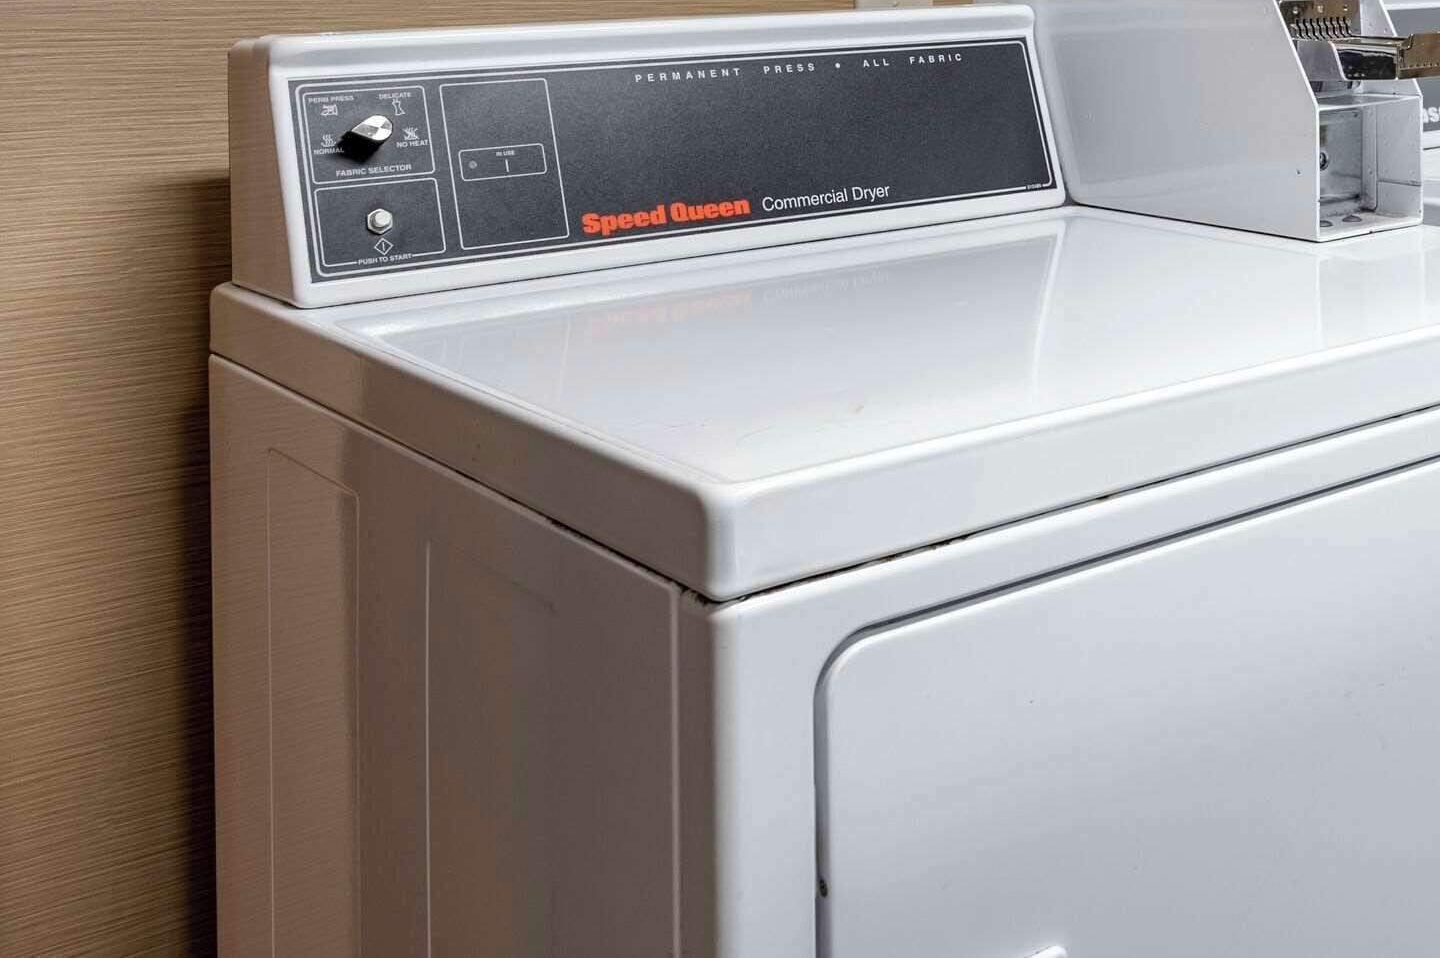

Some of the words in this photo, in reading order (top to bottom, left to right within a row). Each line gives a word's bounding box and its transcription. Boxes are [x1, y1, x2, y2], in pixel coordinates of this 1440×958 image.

[635, 67, 741, 83] PERMANENT
[763, 62, 816, 76] PRESS
[862, 58, 890, 68] ALL
[909, 53, 963, 65] FABRIC
[330, 95, 355, 103] PRESS
[378, 92, 413, 100] DELICATE
[409, 139, 430, 147] HEAT
[313, 147, 345, 155] NORMAL
[335, 167, 367, 177] FABRIC
[368, 163, 412, 174] SELECTOR
[582, 205, 668, 236] Speed
[670, 198, 752, 222] Queen
[762, 188, 848, 212] Commercial
[852, 184, 891, 203] Dryer
[358, 257, 378, 266] PUSH
[379, 255, 389, 263] TO
[389, 252, 412, 262] START
